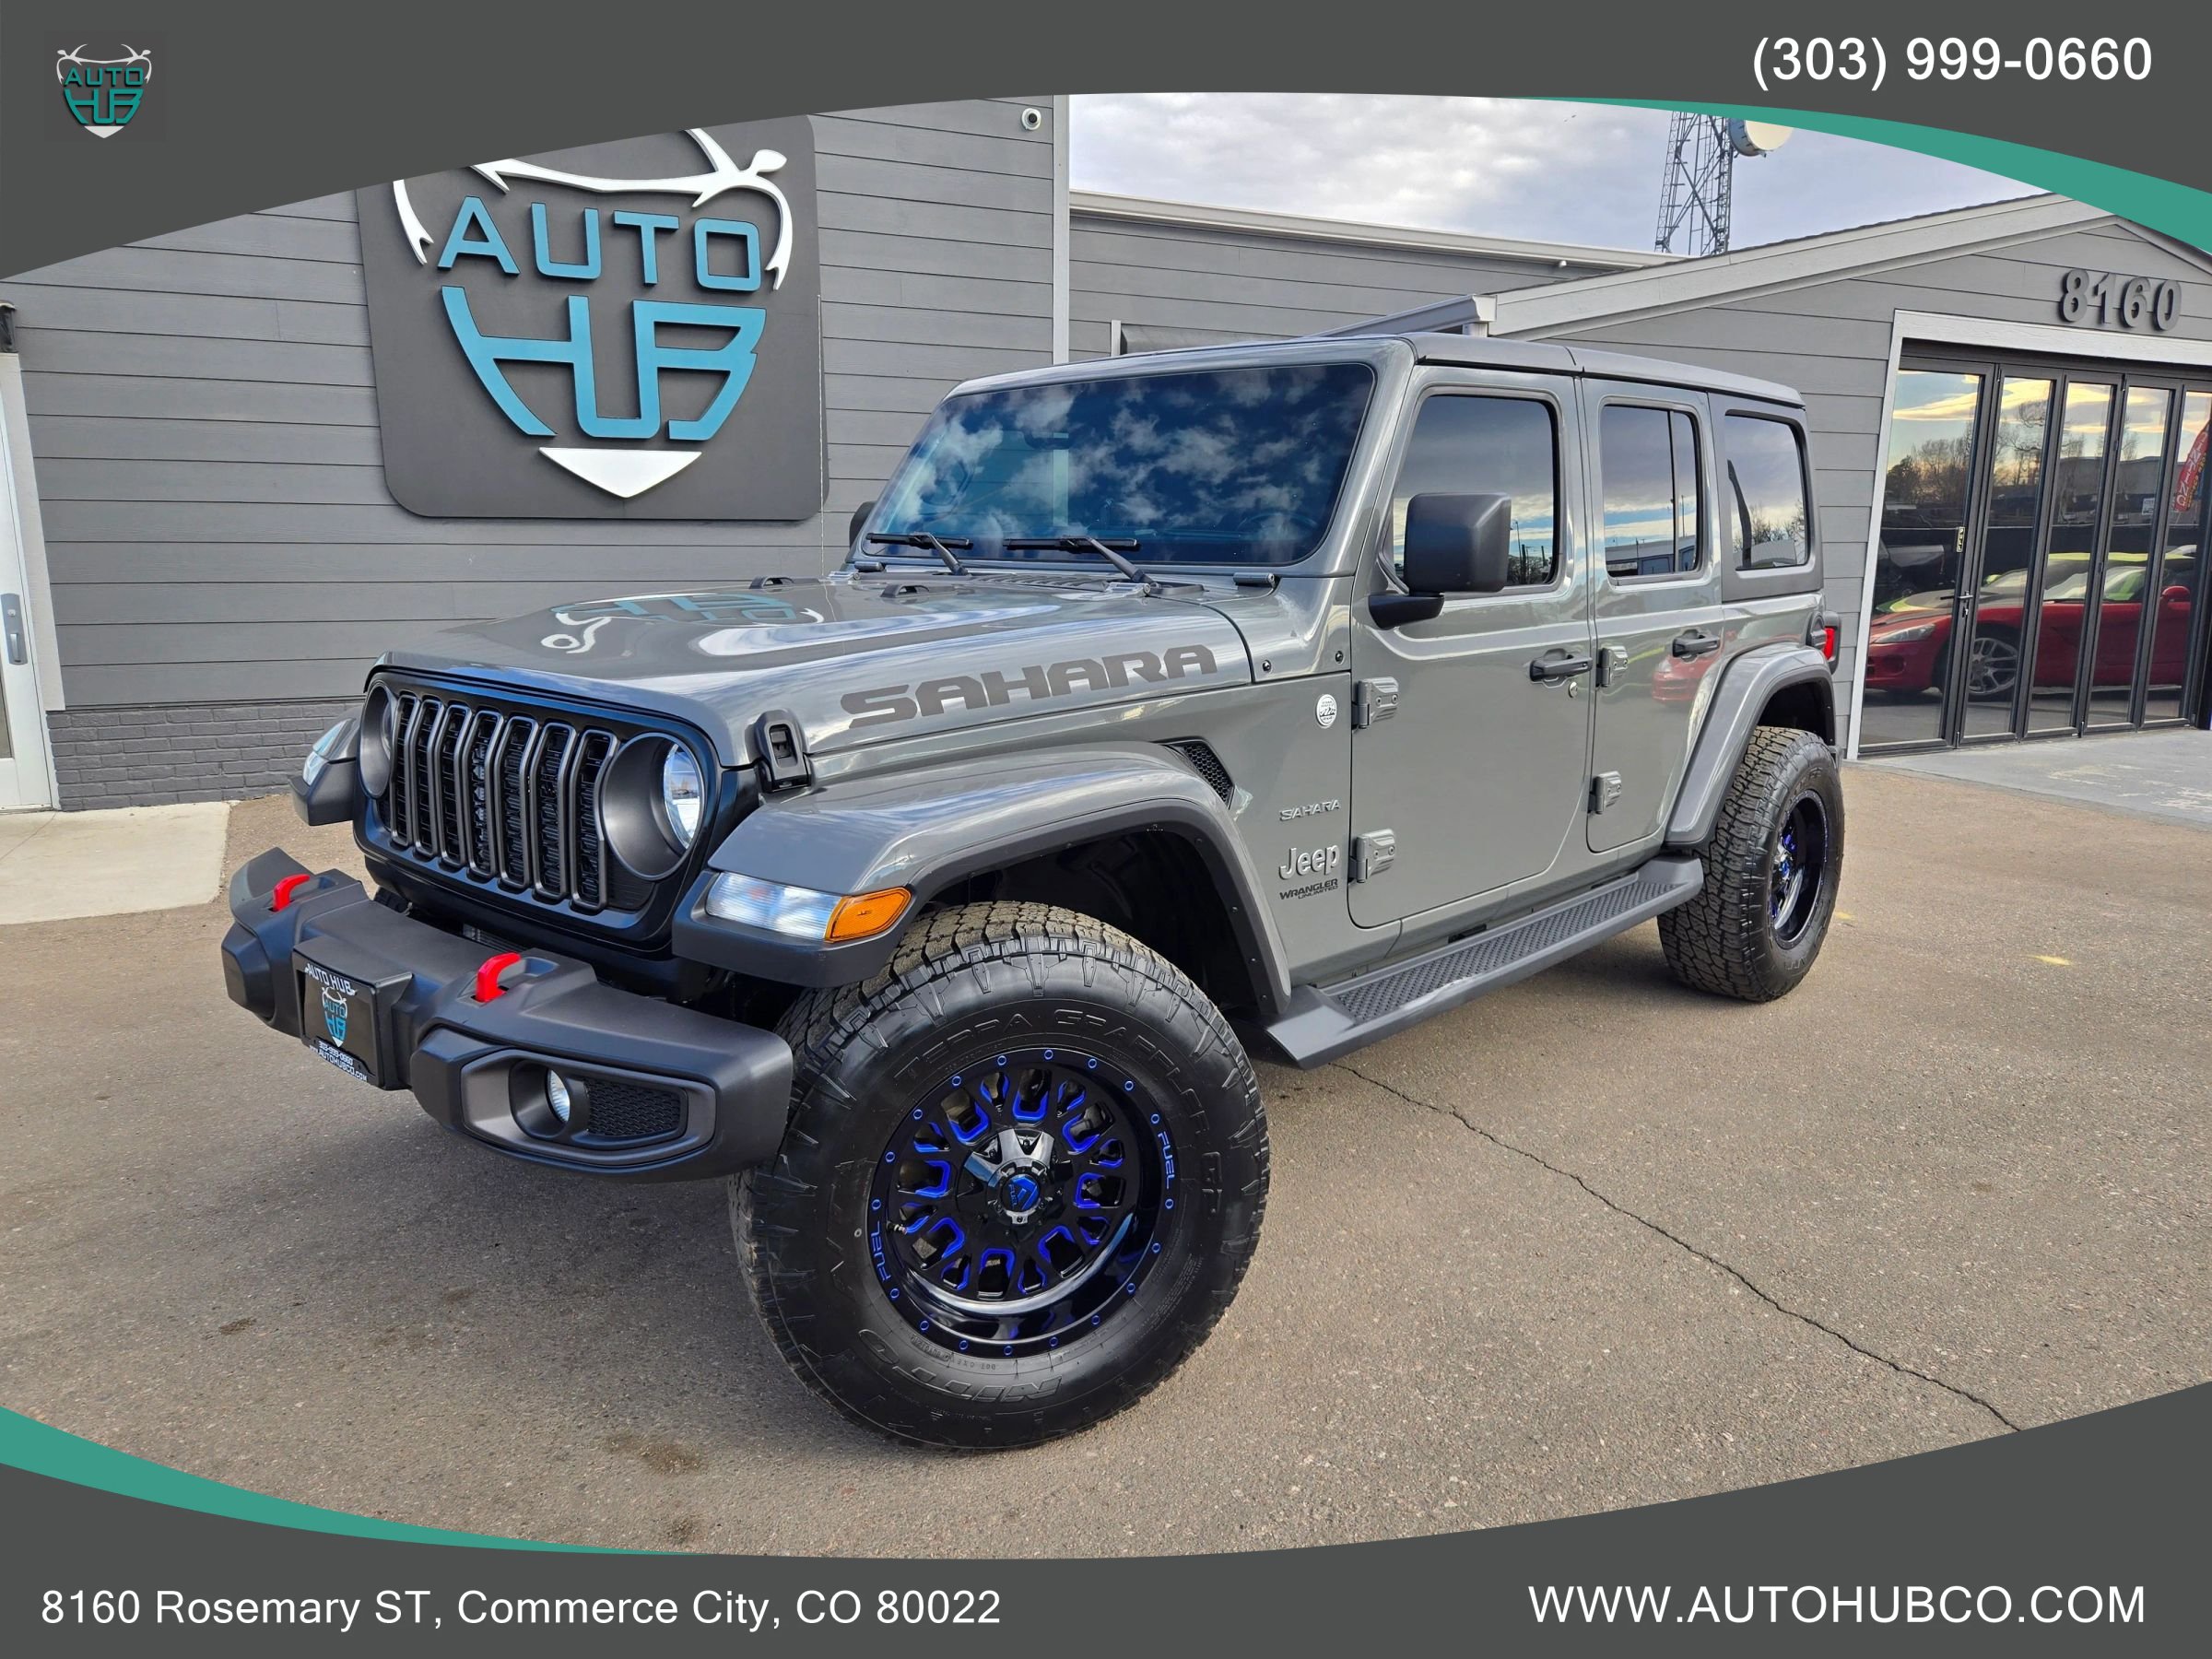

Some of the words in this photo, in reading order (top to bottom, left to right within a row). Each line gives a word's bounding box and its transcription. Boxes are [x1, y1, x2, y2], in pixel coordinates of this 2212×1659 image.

[437, 195, 761, 292] AUTO
[2059, 268, 2182, 331] 8160
[441, 287, 766, 441] HUB
[840, 644, 1218, 729] SAHARA
[1279, 799, 1340, 821] SAHARA
[1278, 844, 1341, 880] Jeep
[1279, 878, 1338, 900] WRANGLER
[1298, 885, 1338, 900] UNLIMITED
[307, 963, 330, 985] AUTO
[332, 974, 353, 995] HUB
[324, 999, 346, 1017] AUTO
[1157, 1130, 1176, 1190] FUEL
[871, 1220, 891, 1282] FUEL
[858, 1329, 1063, 1403] NITTO
